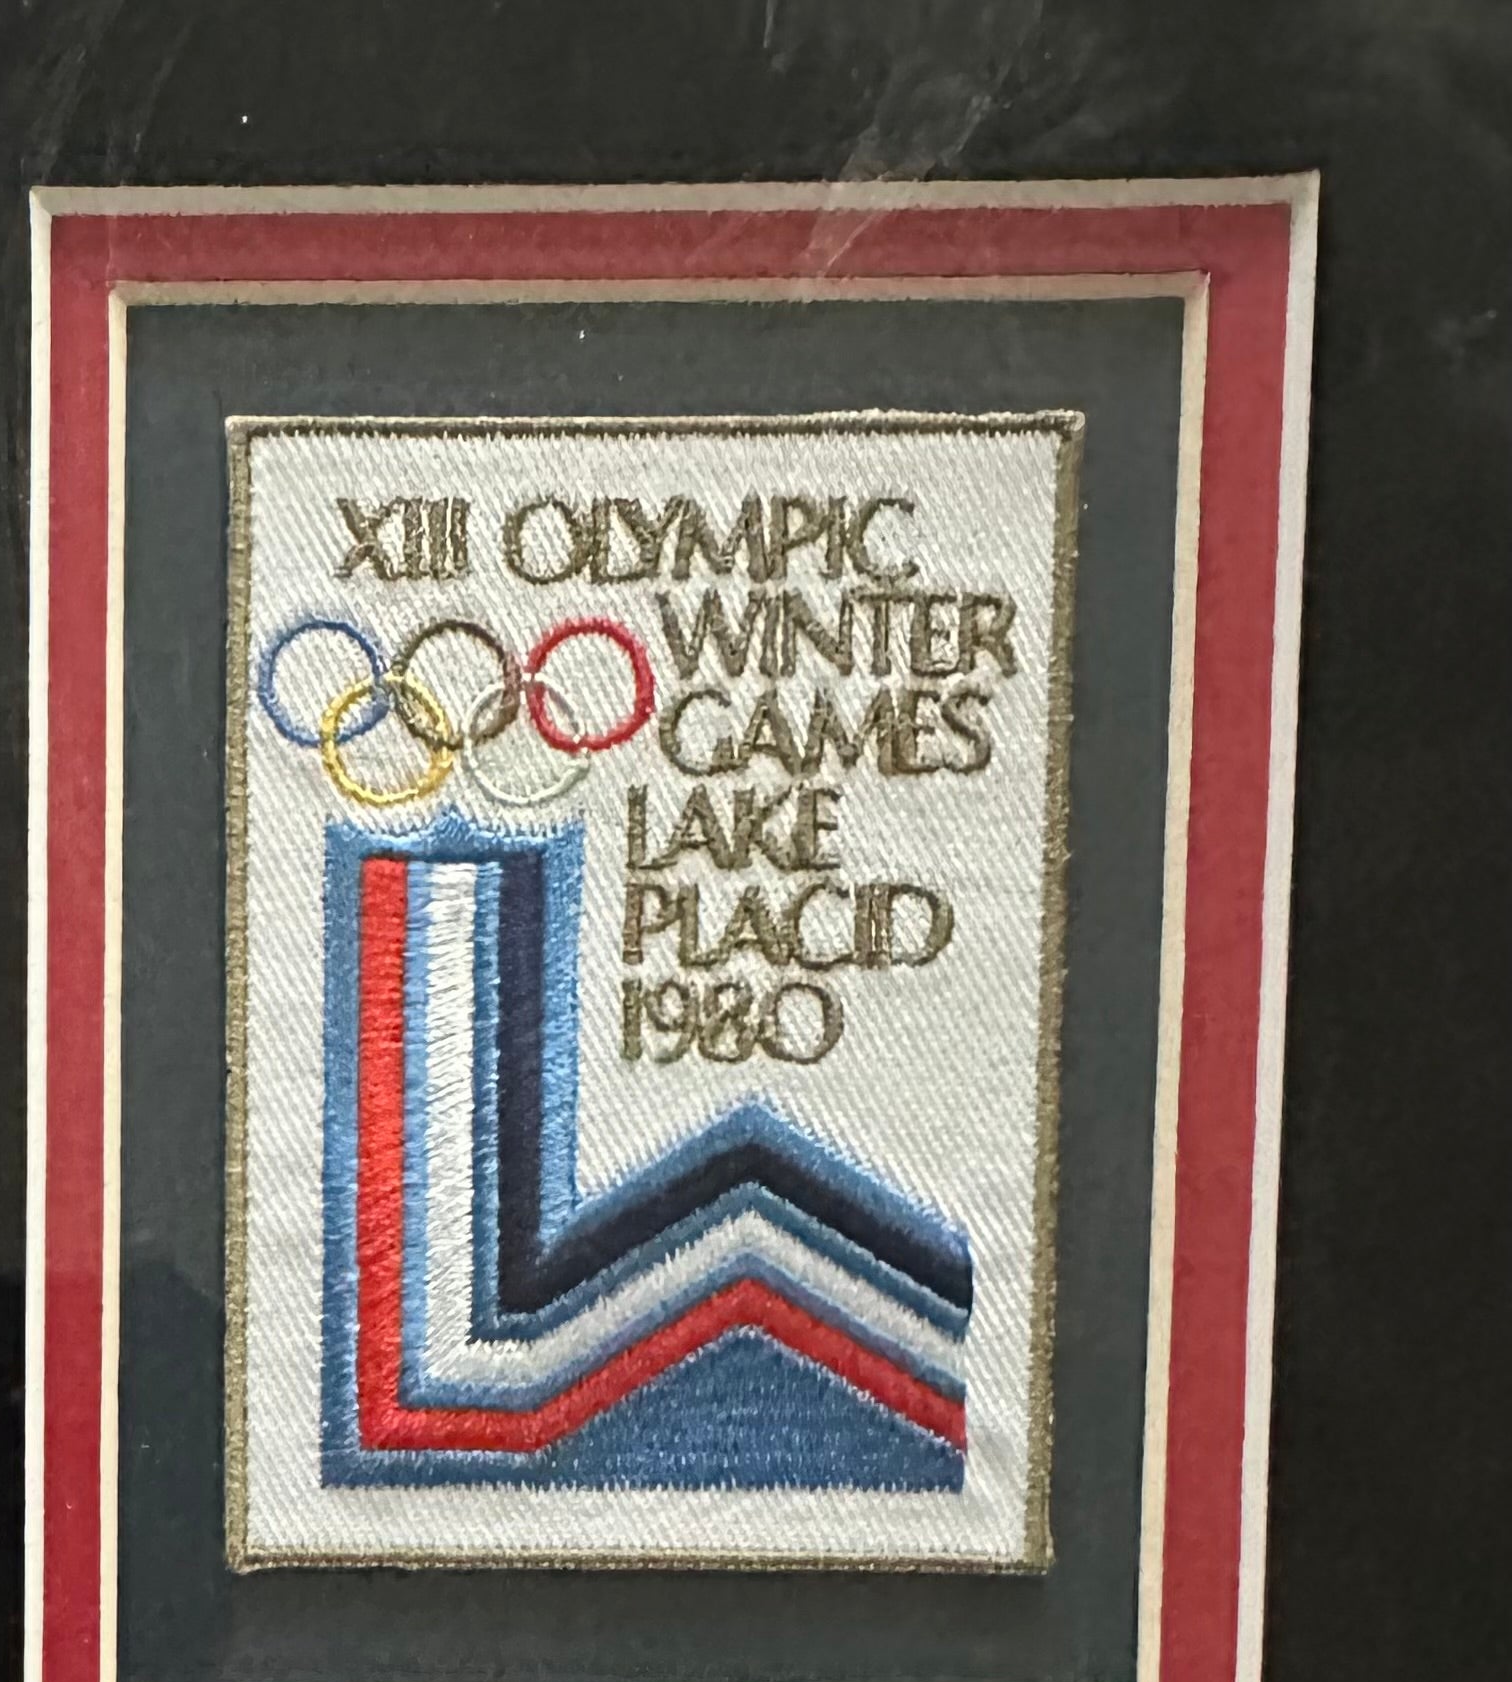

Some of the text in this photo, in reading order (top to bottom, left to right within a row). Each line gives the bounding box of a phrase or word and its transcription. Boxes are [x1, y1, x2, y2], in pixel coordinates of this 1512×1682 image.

[335, 493, 920, 584] XIII OLYMPIC
[655, 588, 1018, 680] WINTER
[660, 688, 996, 778] GAMES
[624, 783, 843, 871] LAKE
[622, 881, 955, 969] PLACID
[620, 976, 846, 1065] 1980
